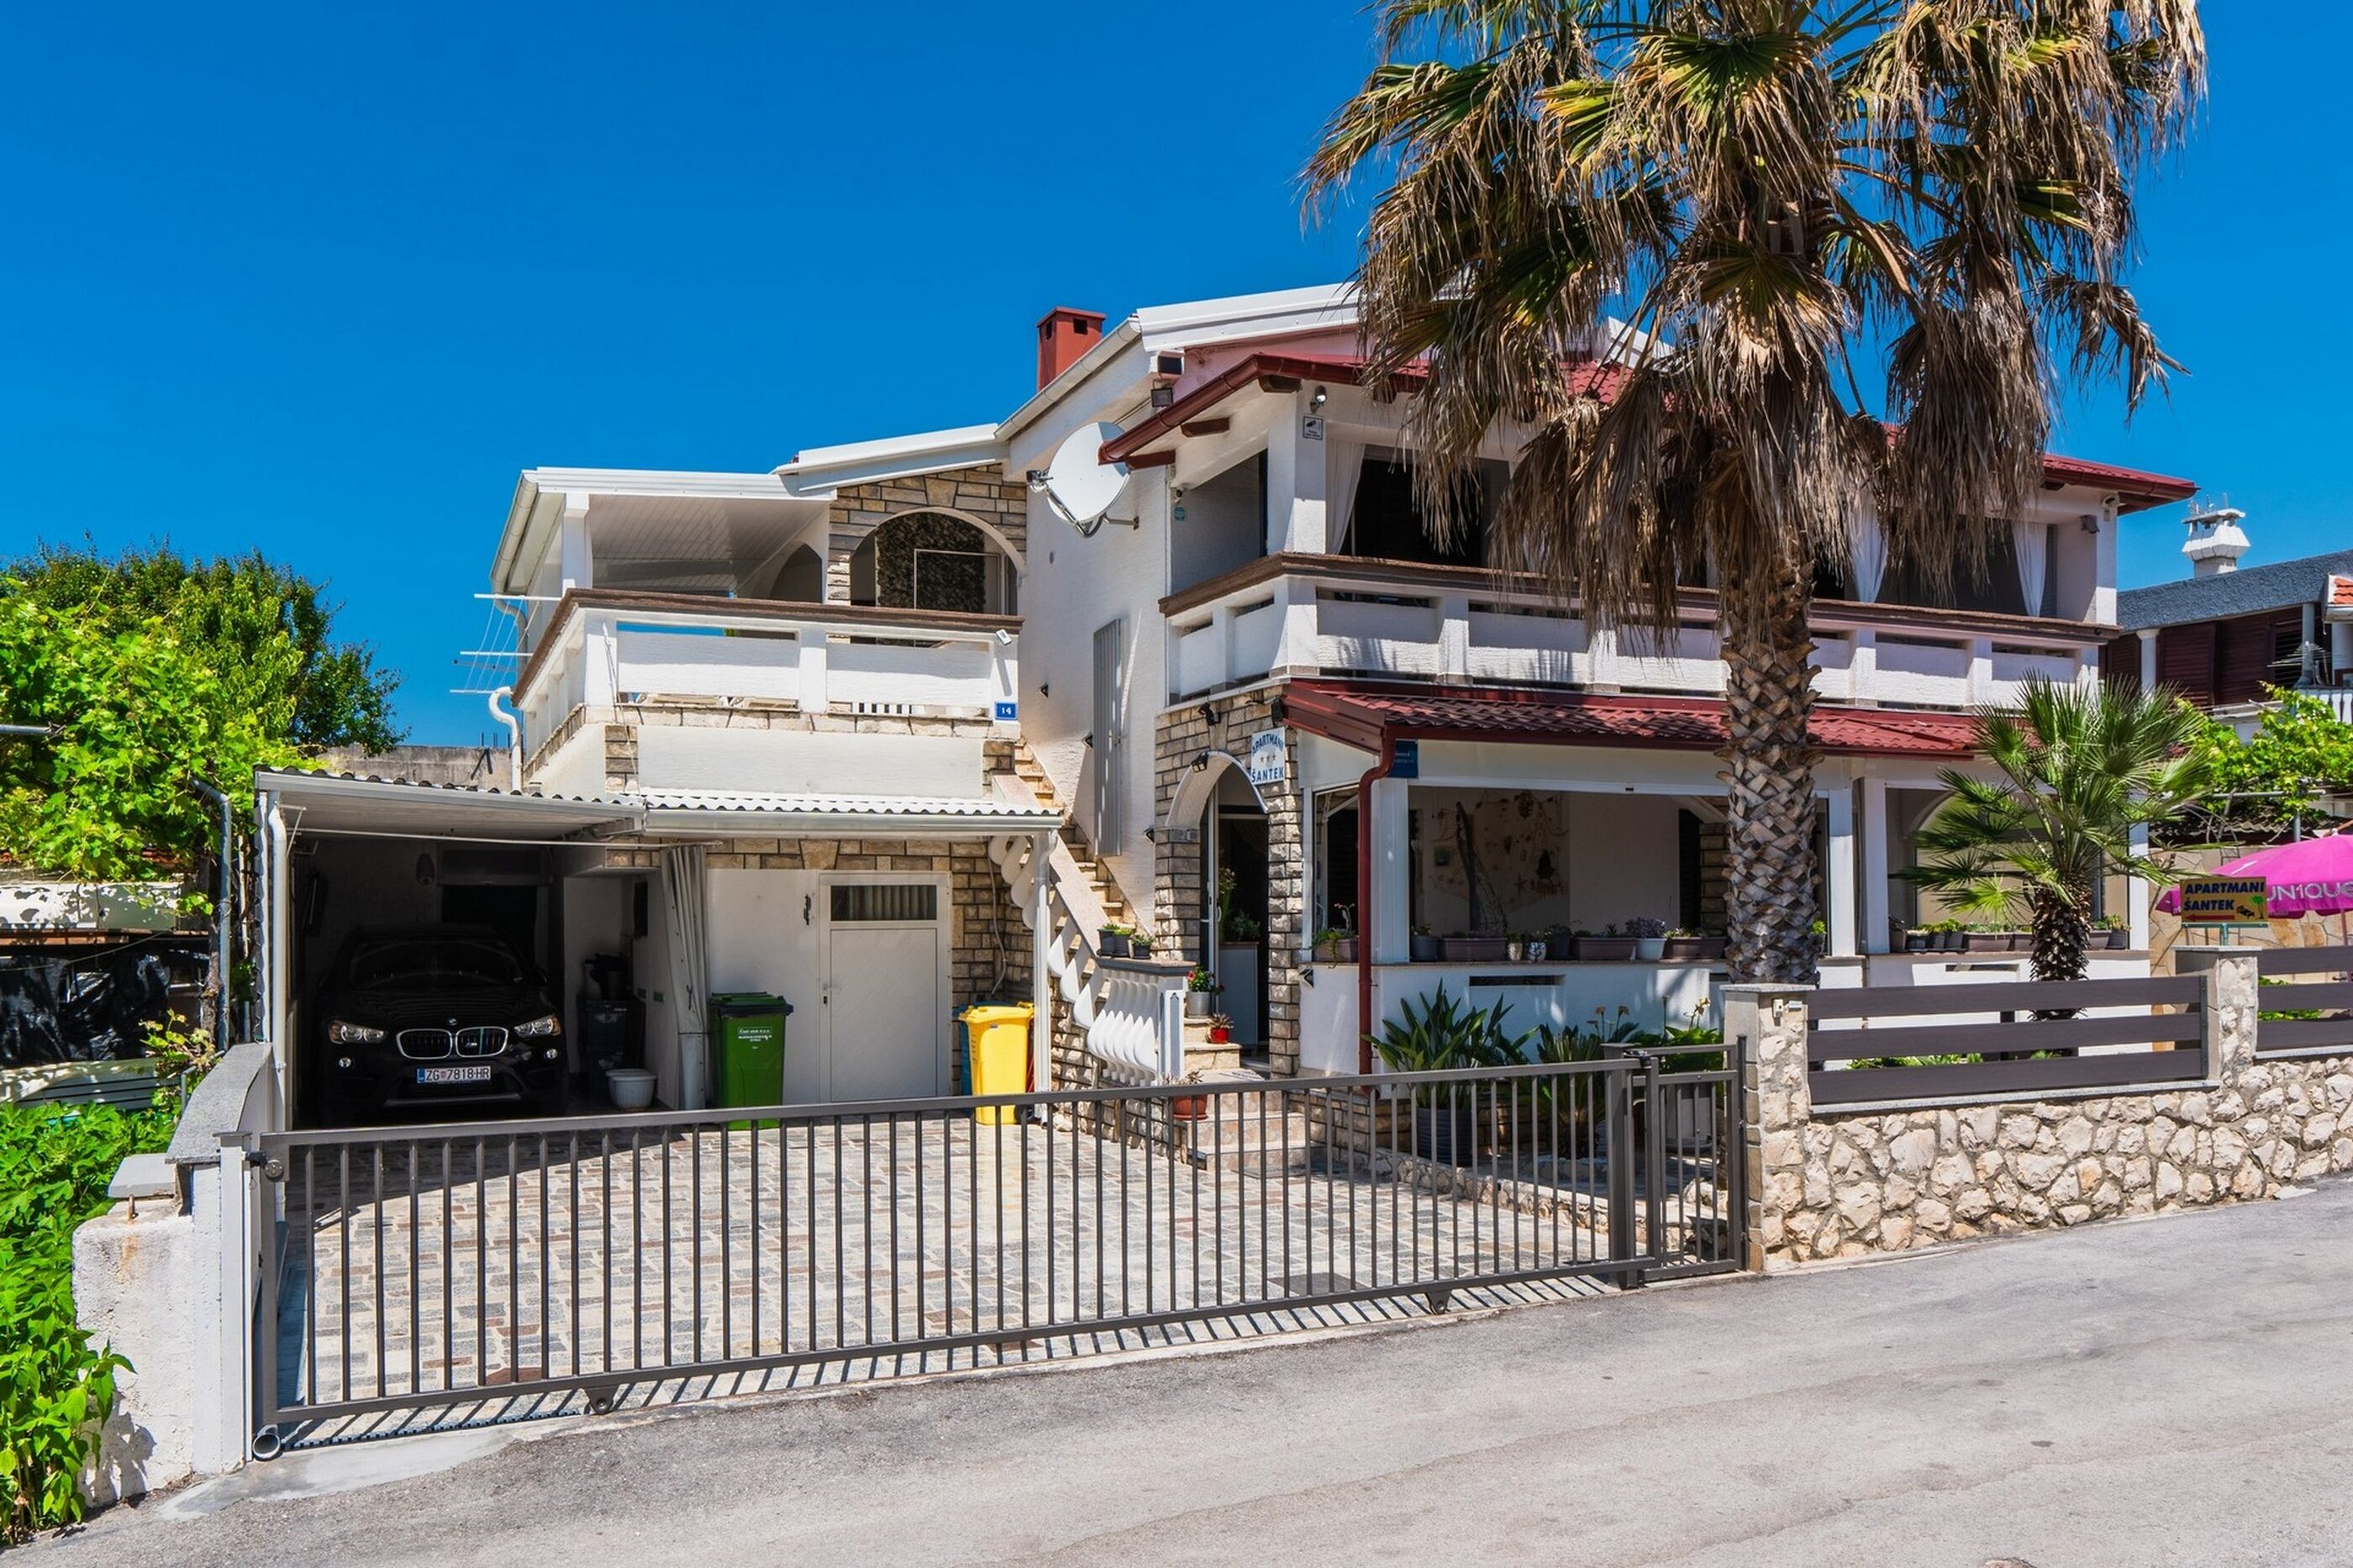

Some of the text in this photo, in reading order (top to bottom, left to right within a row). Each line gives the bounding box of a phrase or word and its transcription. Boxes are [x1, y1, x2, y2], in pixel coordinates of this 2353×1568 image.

[1001, 707, 1012, 715] 14
[1252, 734, 1284, 755] APARTMANI
[1251, 766, 1284, 782] ŠANTEK
[2185, 881, 2265, 894] APARTMANI
[2183, 897, 2235, 910] ŠANTEK
[426, 1070, 440, 1081] ZG
